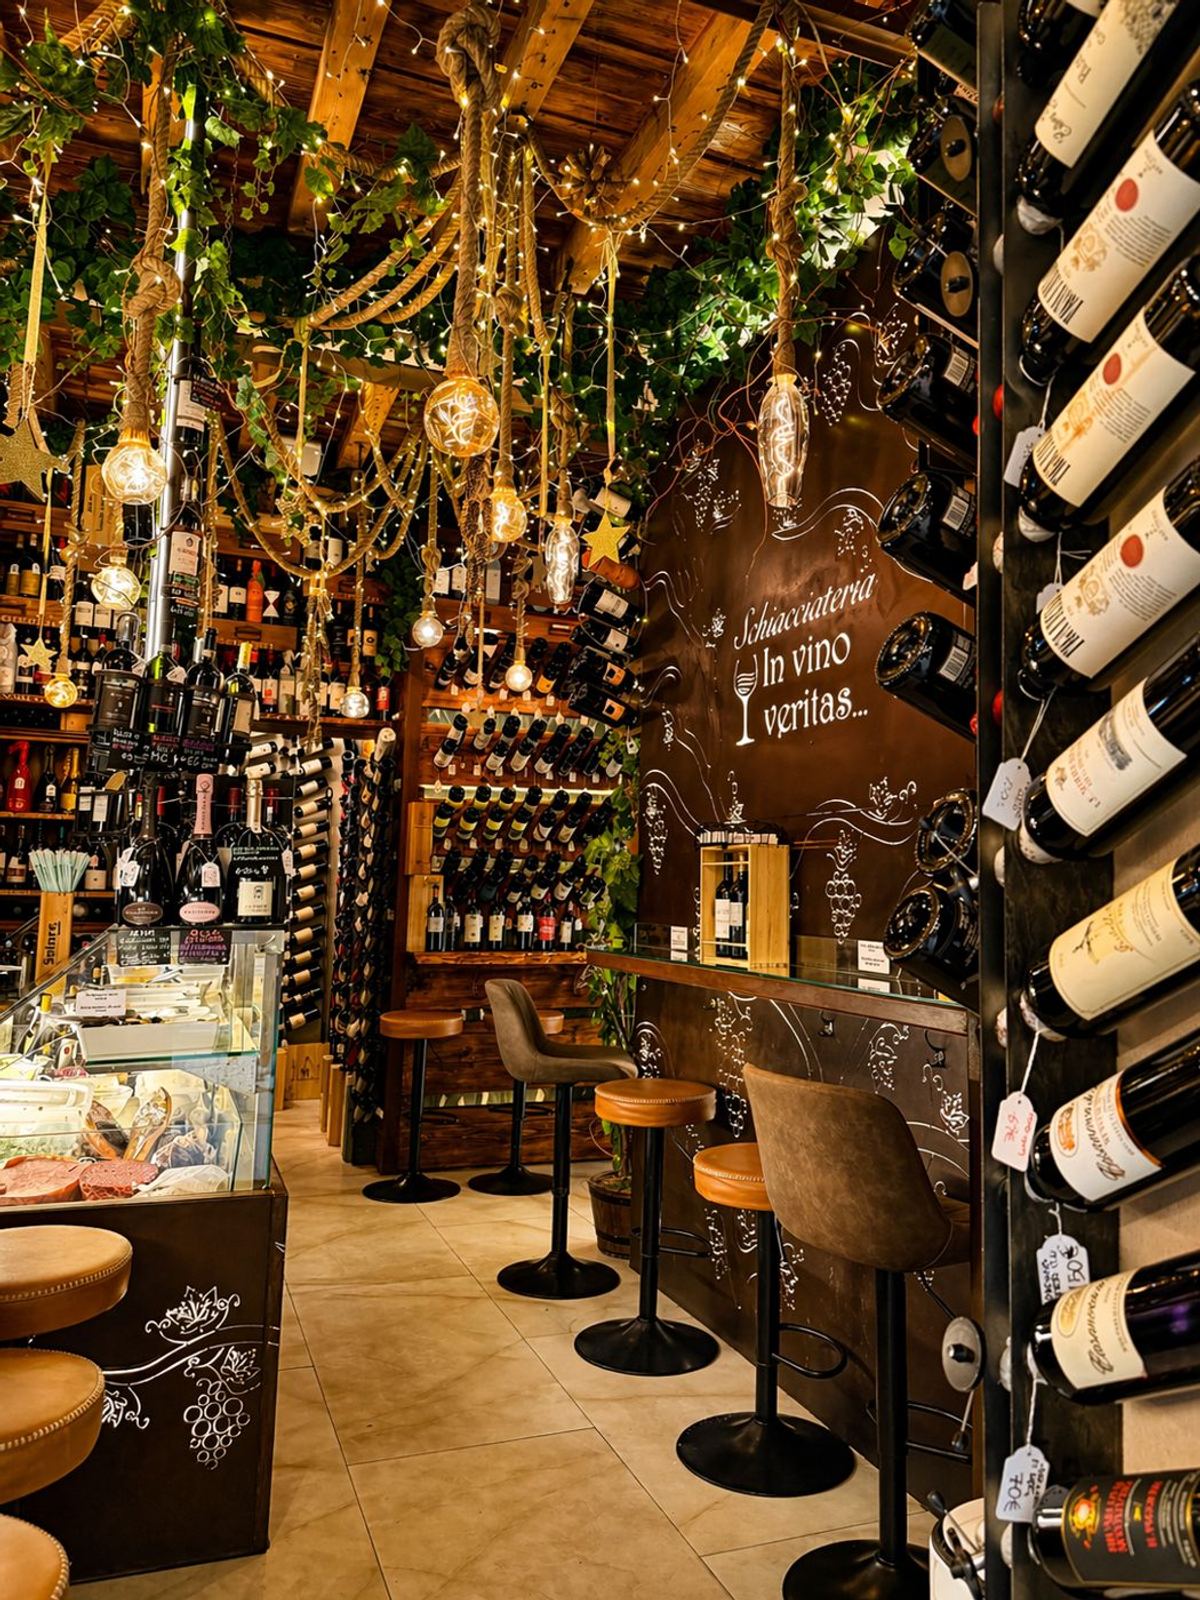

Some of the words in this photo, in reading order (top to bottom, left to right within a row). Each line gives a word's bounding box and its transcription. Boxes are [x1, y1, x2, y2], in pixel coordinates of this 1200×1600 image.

[733, 572, 876, 651] Schiacciateria
[763, 647, 785, 687] In
[792, 632, 851, 677] vino
[763, 687, 869, 739] veritas...
[1003, 1472, 1024, 1512] 70€
